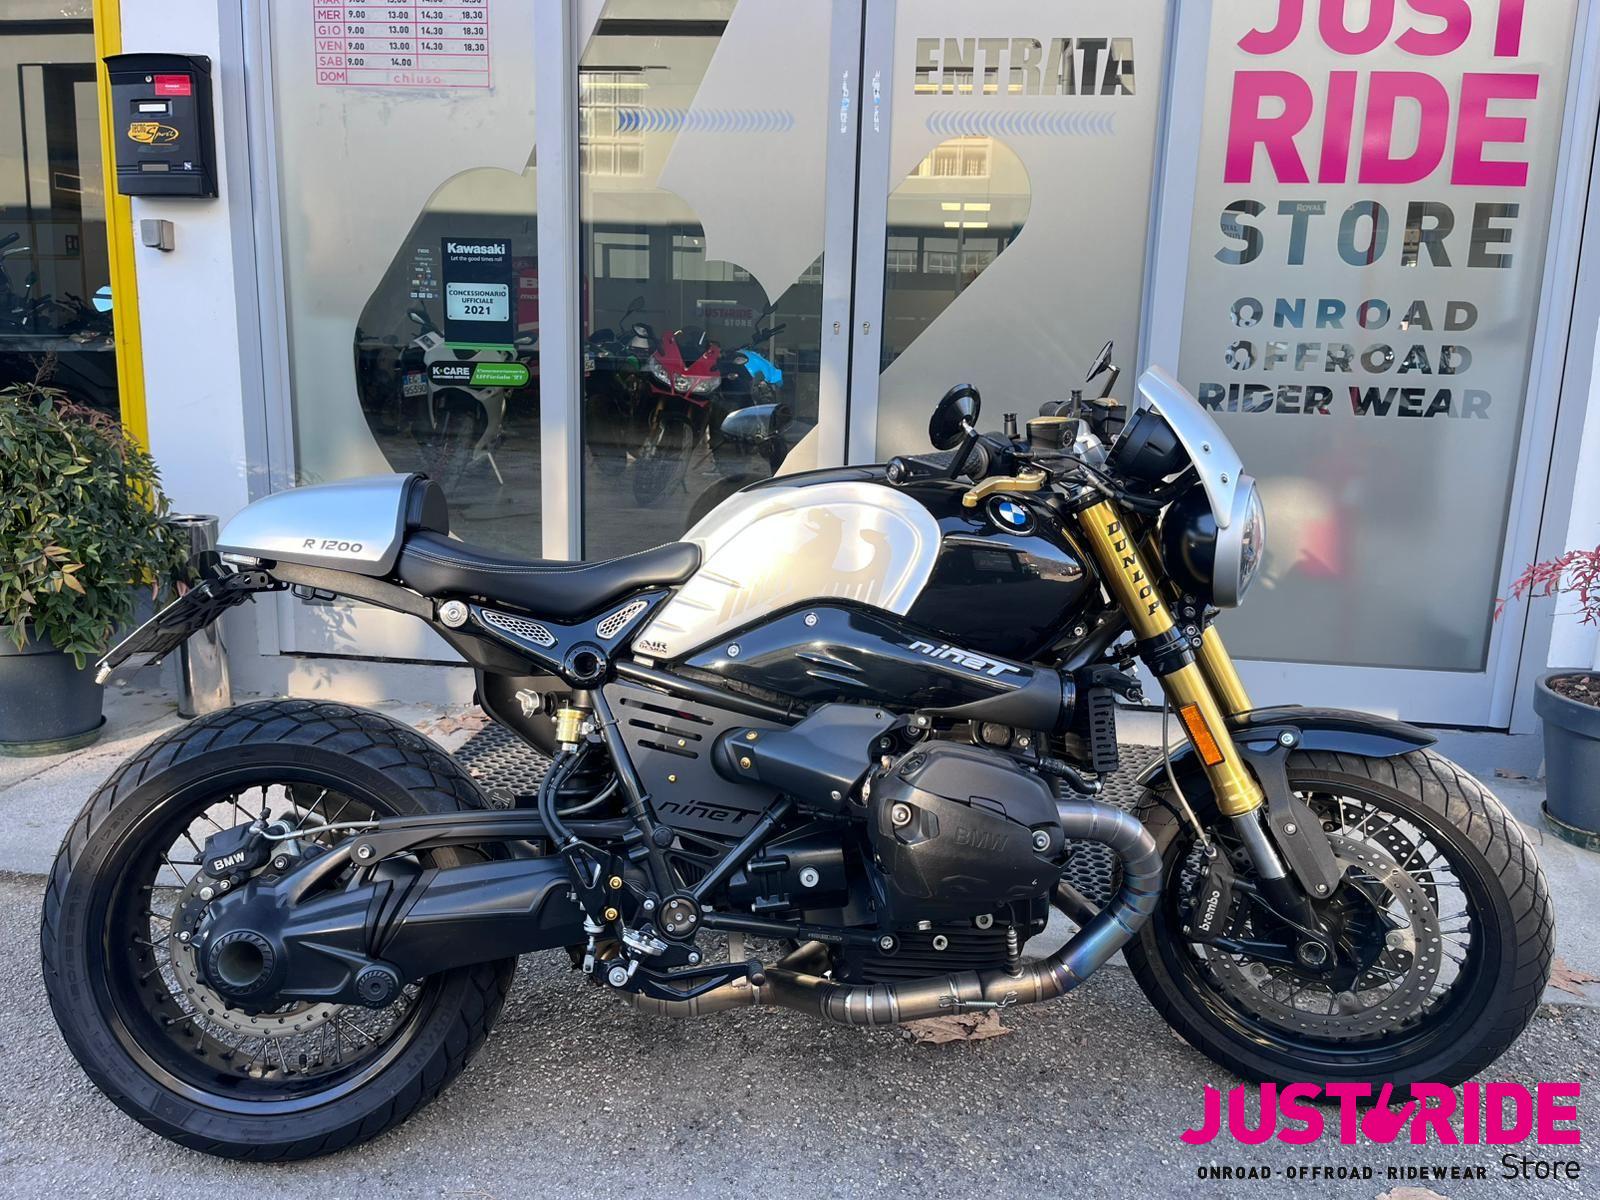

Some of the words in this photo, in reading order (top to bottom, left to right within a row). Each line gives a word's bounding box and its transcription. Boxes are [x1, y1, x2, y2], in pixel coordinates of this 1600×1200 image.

[318, 10, 340, 20] MER
[388, 11, 409, 19] 13.00
[421, 11, 443, 19] 14.30
[462, 11, 483, 19] 18.30
[318, 26, 341, 35] GIO
[388, 26, 409, 34] 13.00
[421, 27, 443, 35] 14.30
[463, 27, 484, 35] 18.30
[319, 41, 342, 50] VEN
[421, 42, 443, 50] 14.30
[319, 57, 343, 66] SAB
[391, 58, 412, 66] 14.00
[914, 37, 1137, 96] ENTRATA
[320, 71, 345, 82] DOM
[393, 73, 442, 84] chiuso
[1223, 71, 1539, 187] RIDE
[1214, 199, 1520, 269] STORE
[447, 242, 506, 255] Kawasaki
[448, 289, 507, 297] CONCESSIONARIO
[464, 305, 491, 315] 2021
[1229, 297, 1479, 332] ONROAD
[1224, 340, 1473, 376] OFFROAD
[1197, 382, 1334, 416] RIDER
[1348, 385, 1493, 420] WEAR
[302, 538, 316, 549] R
[320, 540, 363, 553] 1200
[1106, 520, 1161, 616] DUNLOP
[908, 640, 1021, 677] nineT
[953, 826, 1009, 853] BMW
[213, 851, 245, 871] BMW
[1198, 890, 1221, 932] brembo
